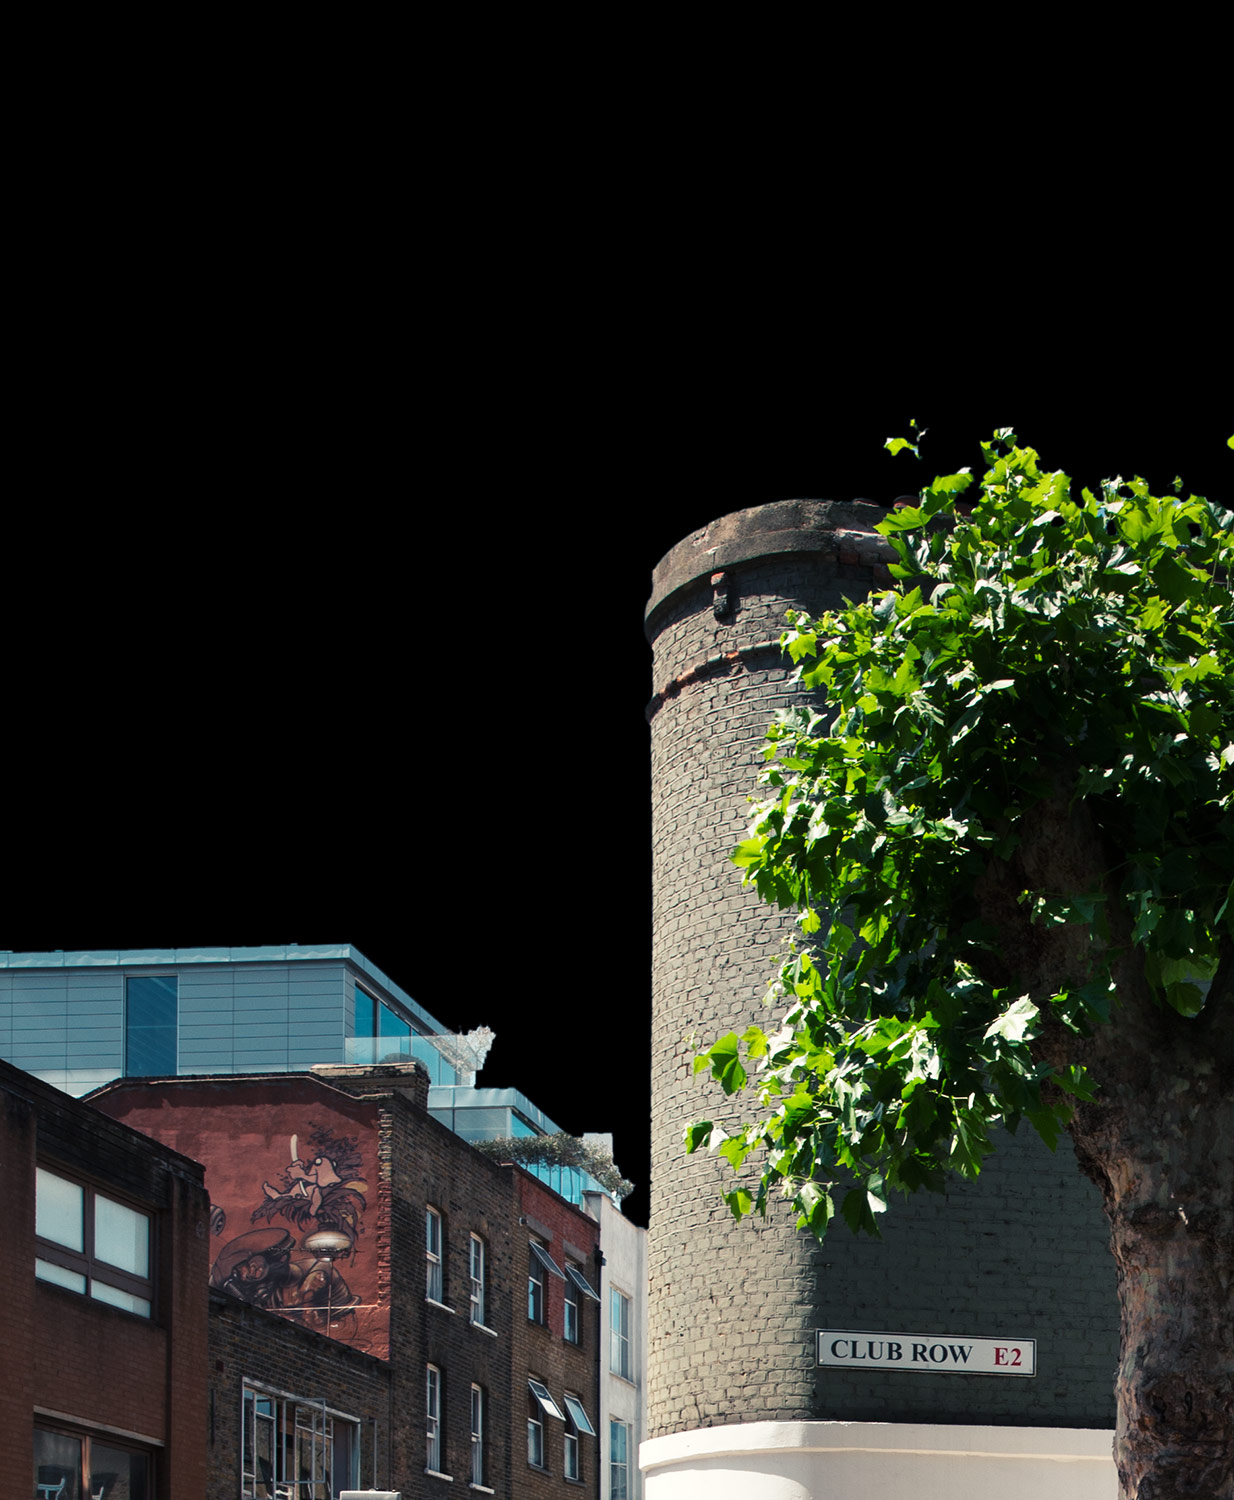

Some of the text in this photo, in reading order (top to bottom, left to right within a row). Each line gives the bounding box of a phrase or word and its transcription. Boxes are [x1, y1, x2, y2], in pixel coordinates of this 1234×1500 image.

[830, 1339, 1022, 1367] CLUB ROW E2
